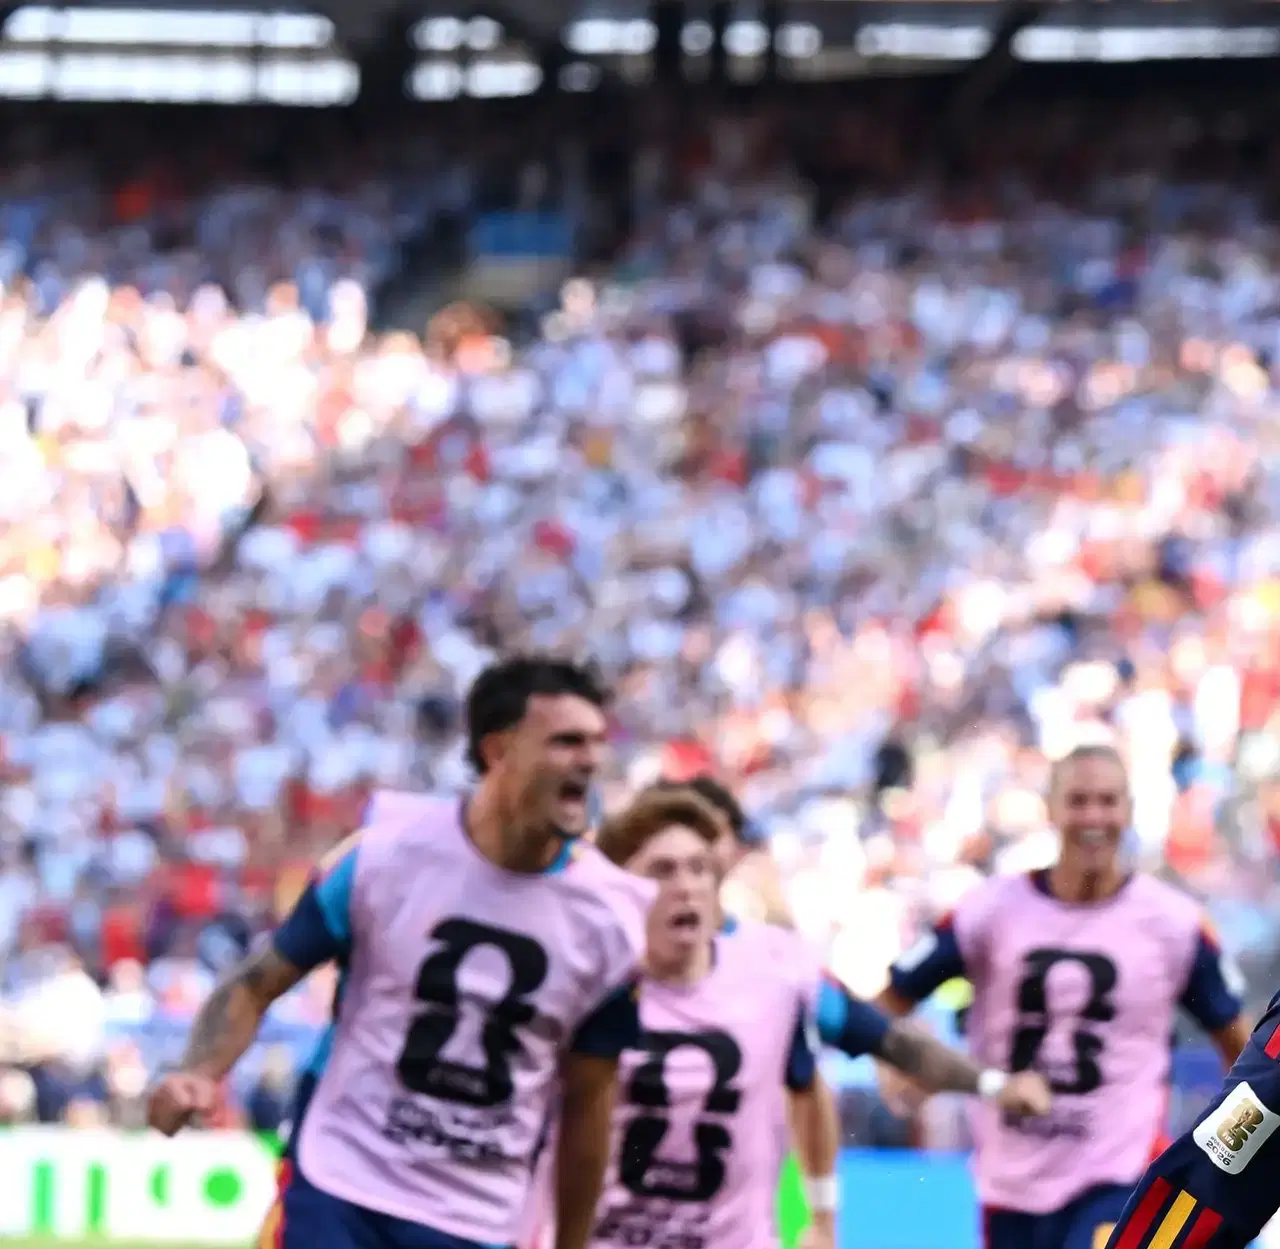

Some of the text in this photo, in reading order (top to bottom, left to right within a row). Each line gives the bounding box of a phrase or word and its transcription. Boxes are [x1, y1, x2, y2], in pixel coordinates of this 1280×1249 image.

[1221, 1131, 1236, 1147] FIFA
[1205, 1140, 1232, 1167] 2026
[1223, 1149, 1237, 1160] CUP
